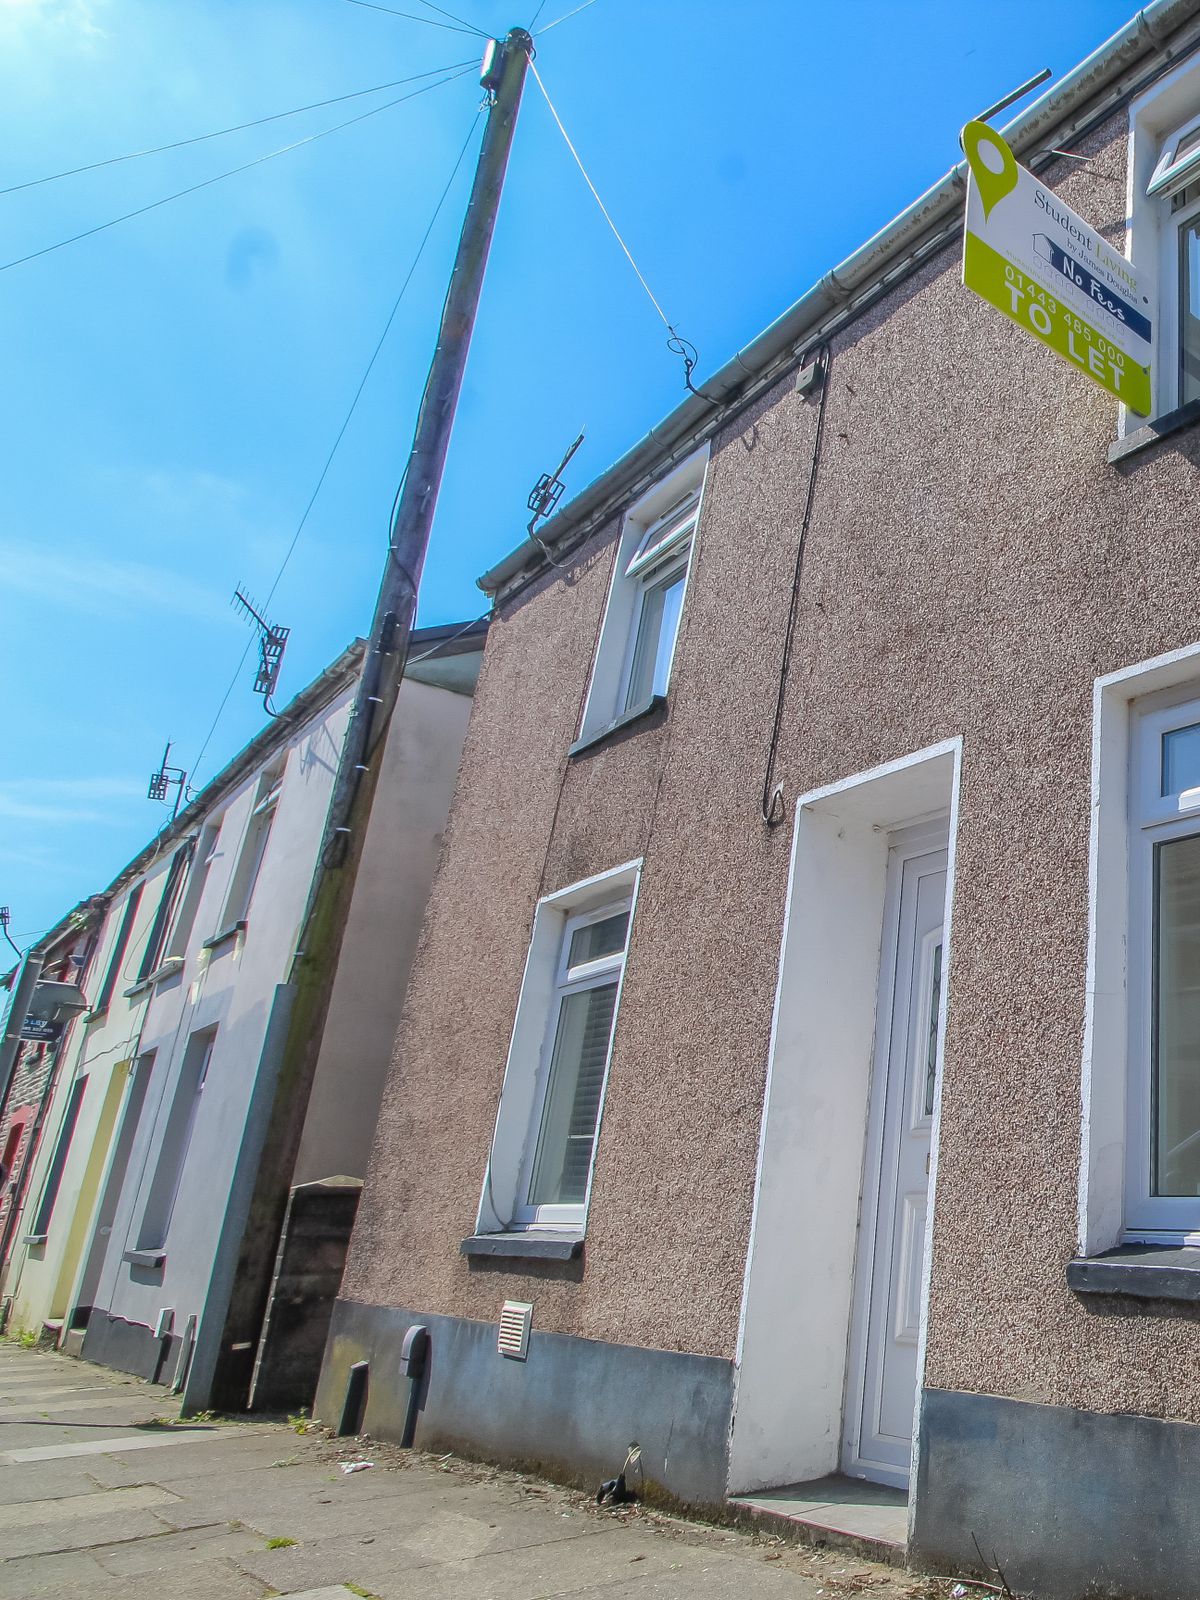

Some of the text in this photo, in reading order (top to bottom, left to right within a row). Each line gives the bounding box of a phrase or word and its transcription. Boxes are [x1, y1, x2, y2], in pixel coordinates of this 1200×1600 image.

[1034, 189, 1137, 293] Student Living
[1063, 256, 1125, 321] No Fees
[1067, 238, 1138, 304] by James Douglas
[1004, 280, 1052, 335] TO
[1068, 329, 1125, 391] LET
[1005, 266, 1125, 367] 01443 485 000
